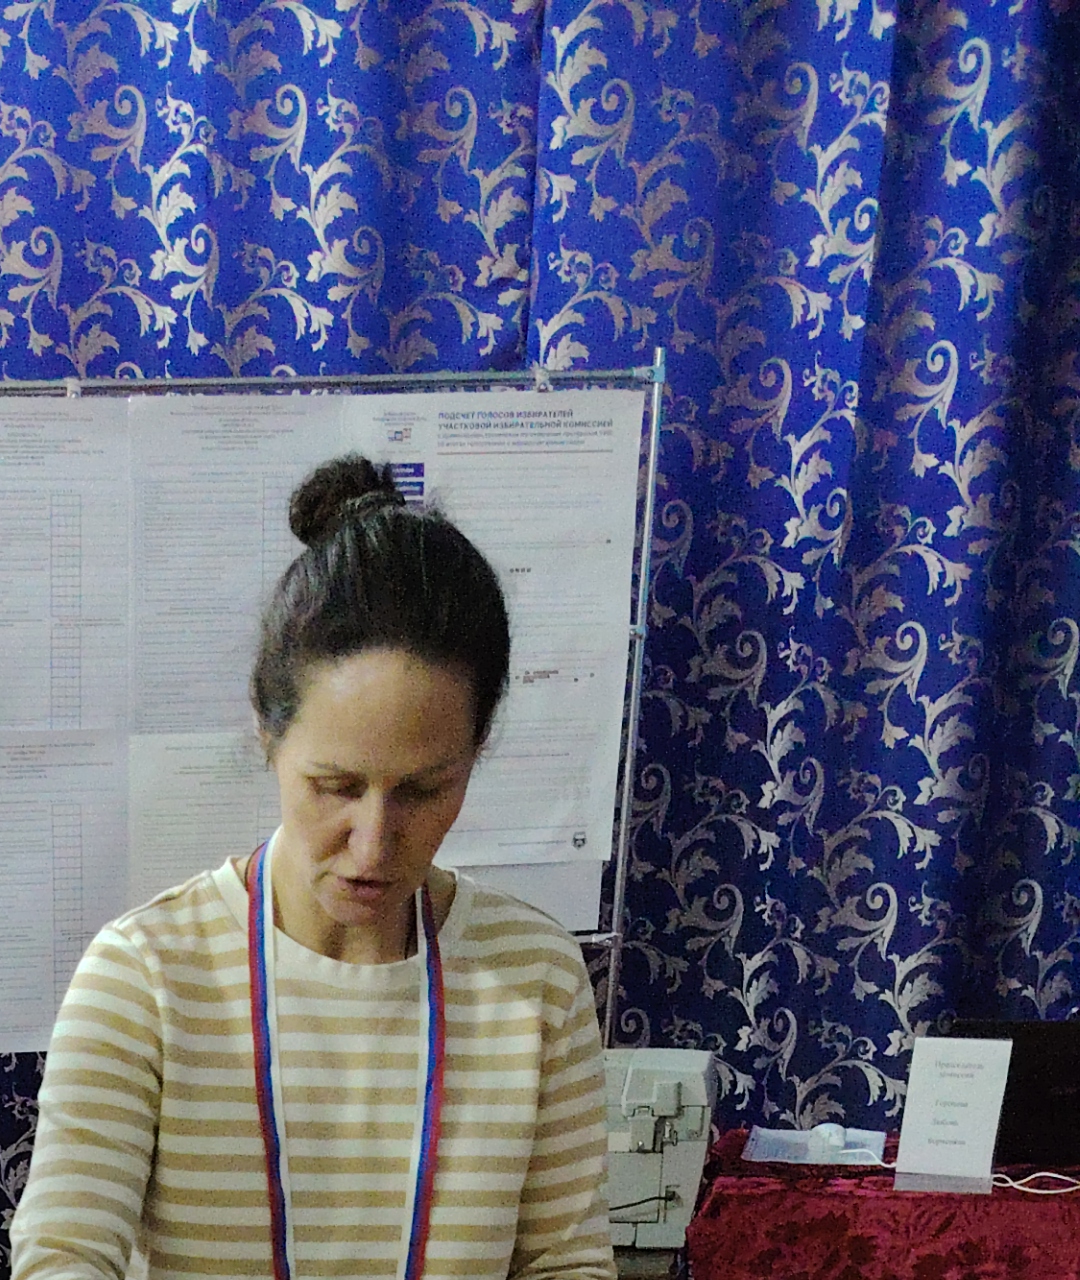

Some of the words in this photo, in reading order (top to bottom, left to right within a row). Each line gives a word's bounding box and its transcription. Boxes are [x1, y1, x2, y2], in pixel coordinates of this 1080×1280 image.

[477, 410, 515, 419] ГОЛОСОВ
[517, 408, 574, 419] ИЗБИРАТЕЛЕЙ
[438, 420, 492, 430] УЧАСТКОВОЙ
